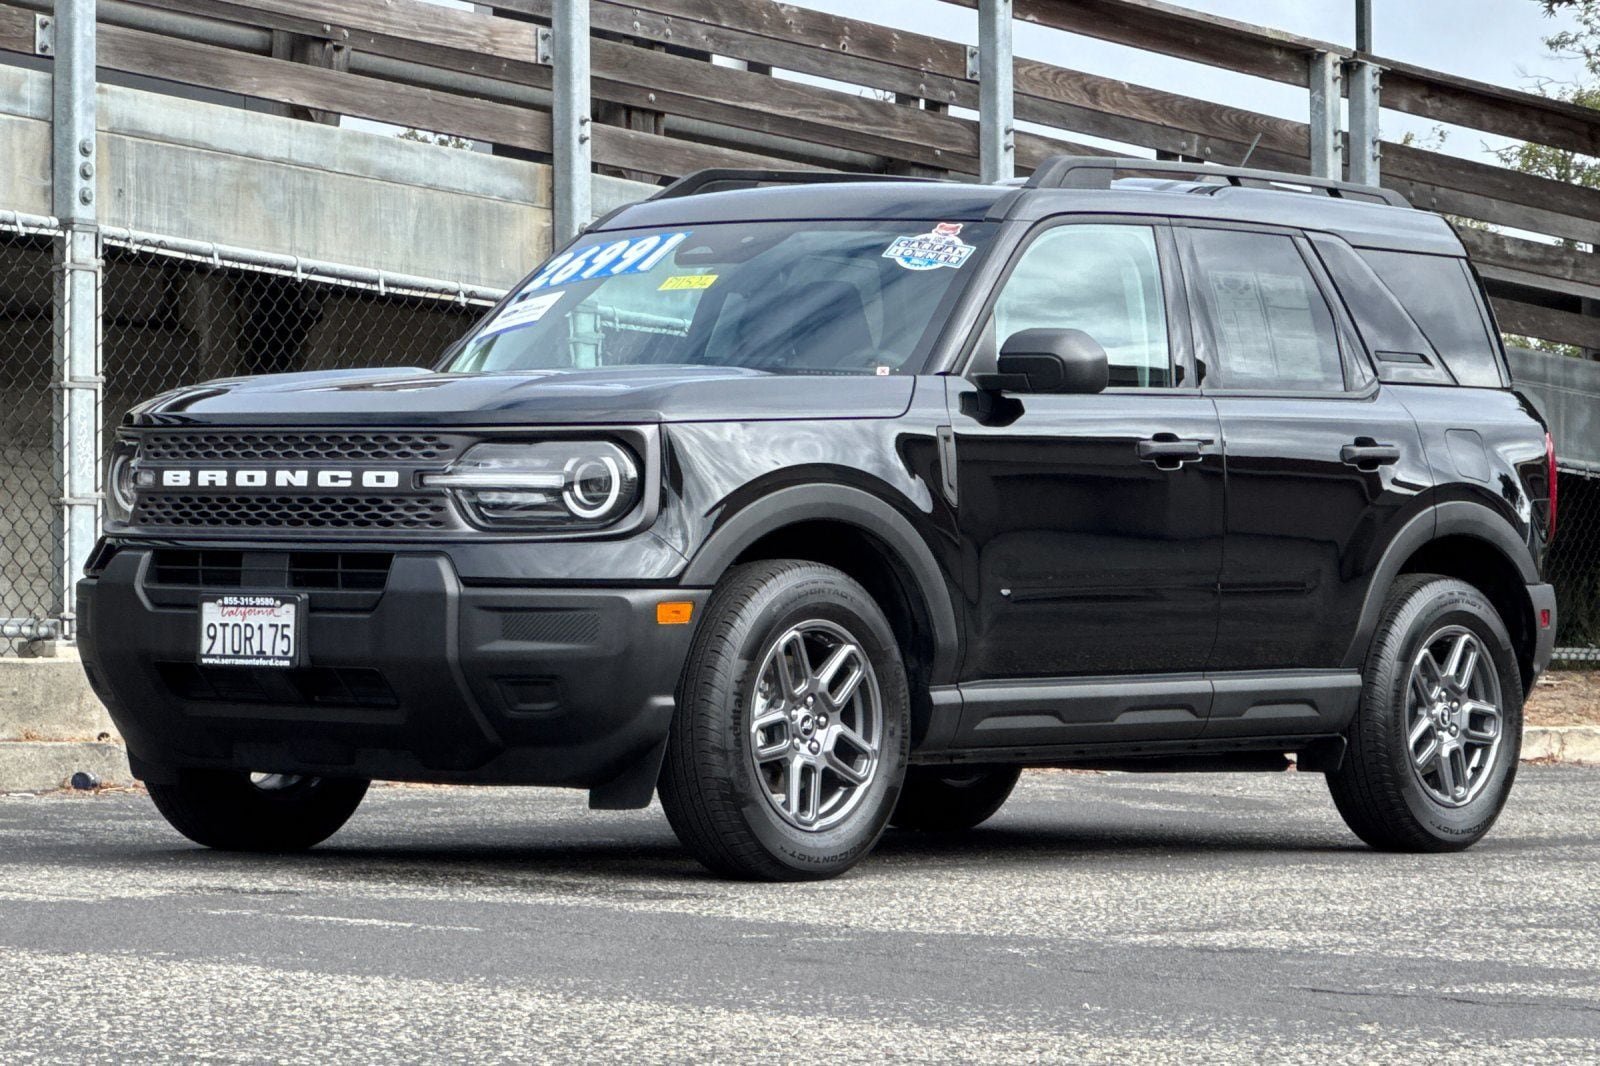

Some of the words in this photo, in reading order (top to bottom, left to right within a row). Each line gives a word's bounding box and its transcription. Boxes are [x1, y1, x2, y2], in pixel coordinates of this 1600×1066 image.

[898, 240, 970, 256] CARFAX
[519, 233, 687, 294] 26991
[162, 470, 399, 488] BRONCO
[220, 606, 281, 622] California
[201, 657, 290, 667] www.serramonteford.com
